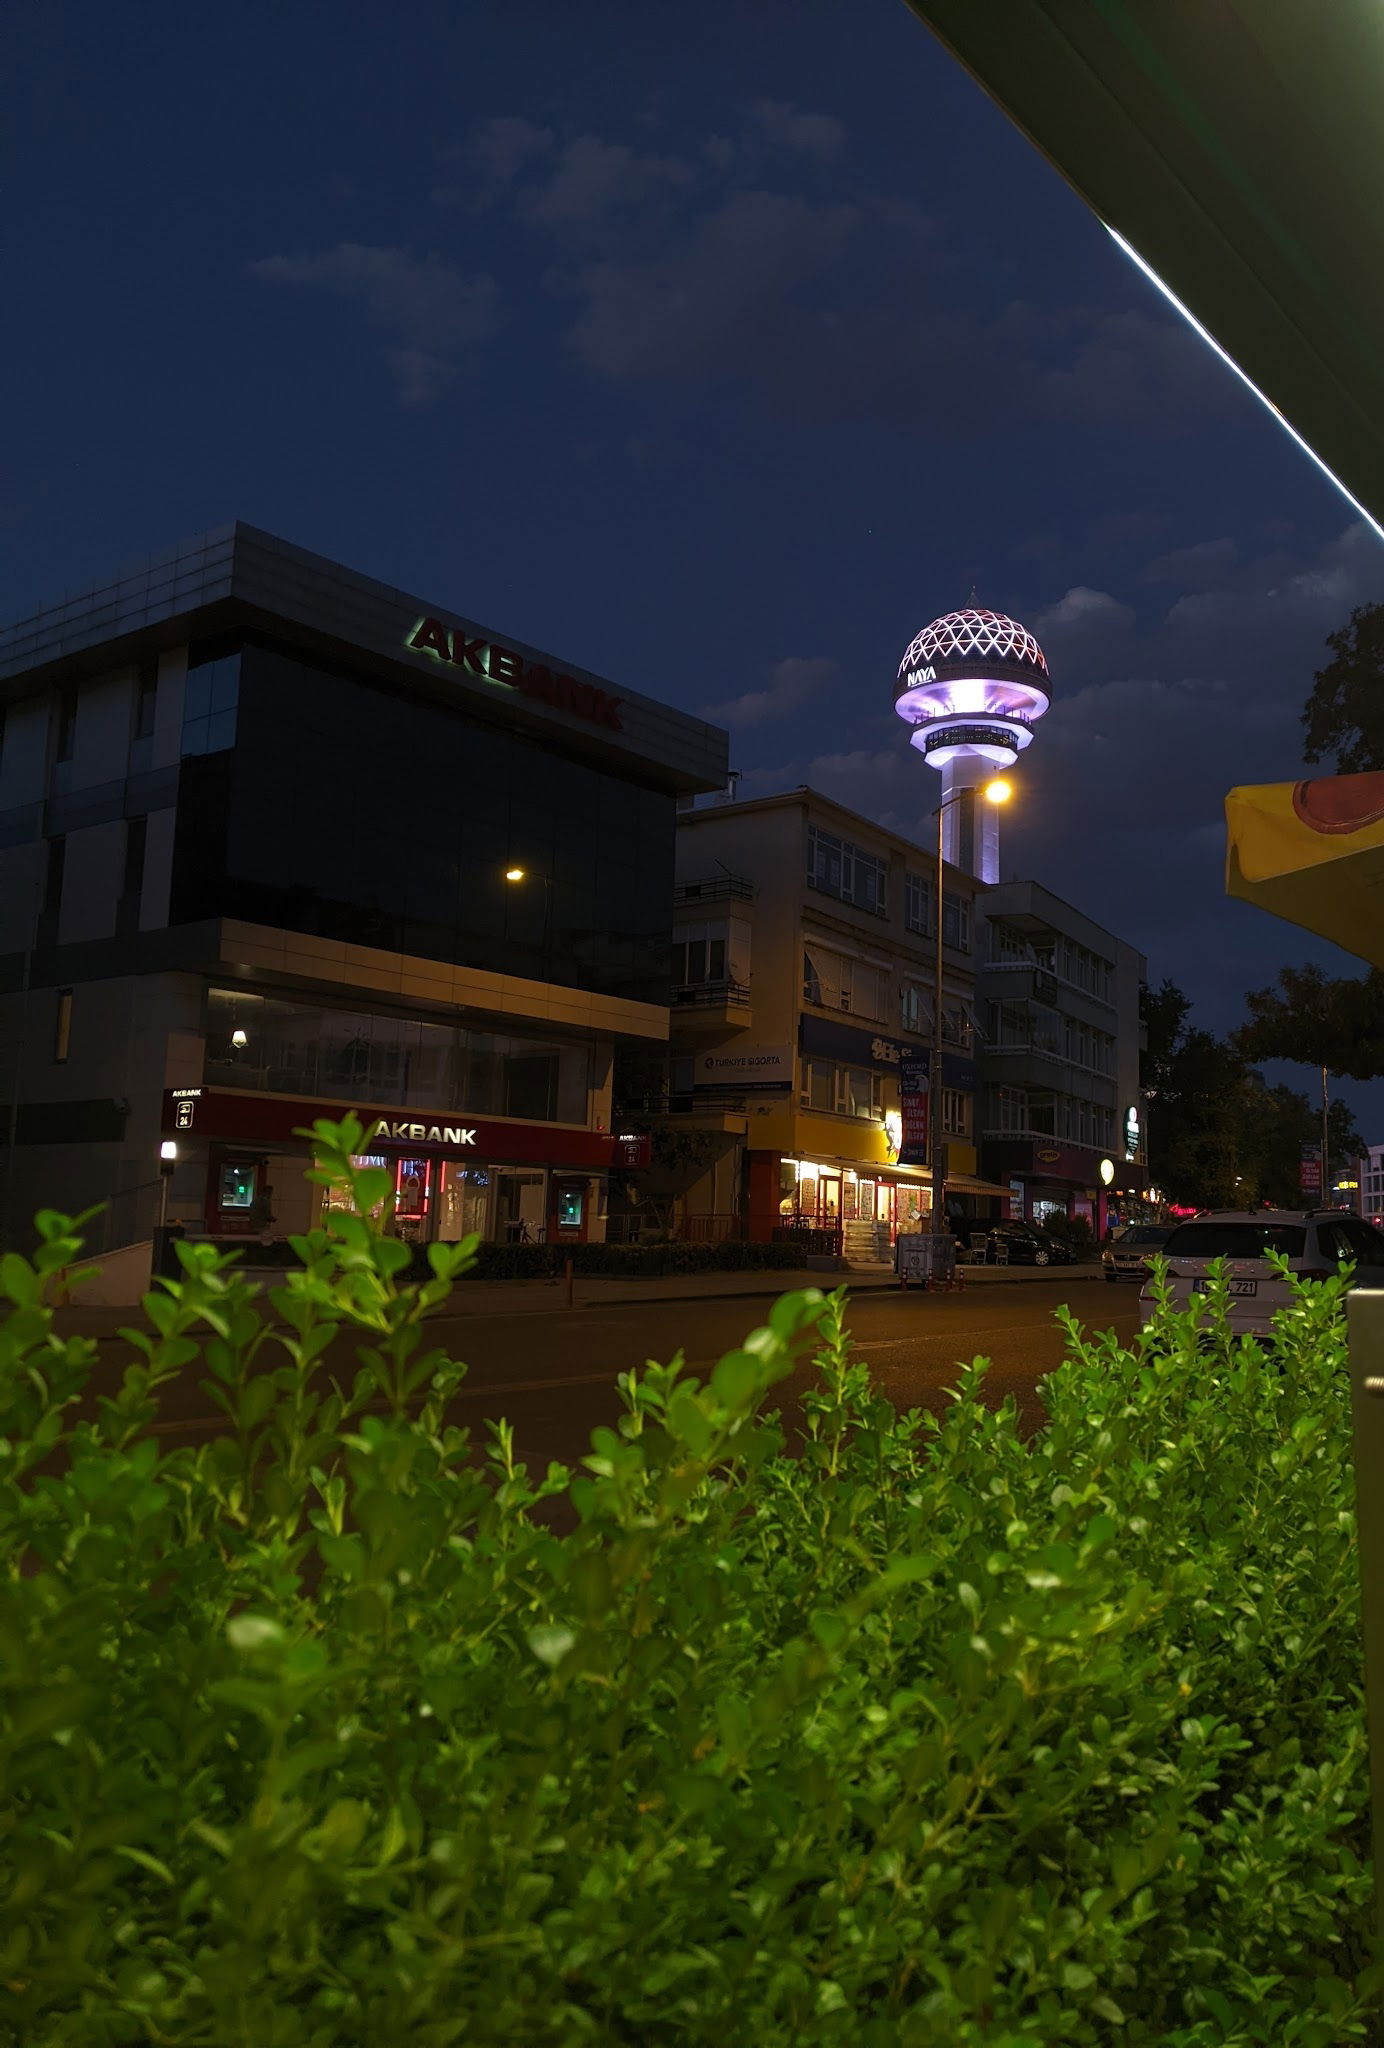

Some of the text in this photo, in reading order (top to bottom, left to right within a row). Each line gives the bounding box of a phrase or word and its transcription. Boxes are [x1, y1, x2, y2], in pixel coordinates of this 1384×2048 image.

[410, 617, 624, 731] AKBANK
[172, 1089, 201, 1097] AKBANK
[374, 1120, 477, 1145] AKBANK
[1236, 1282, 1253, 1292] 721
